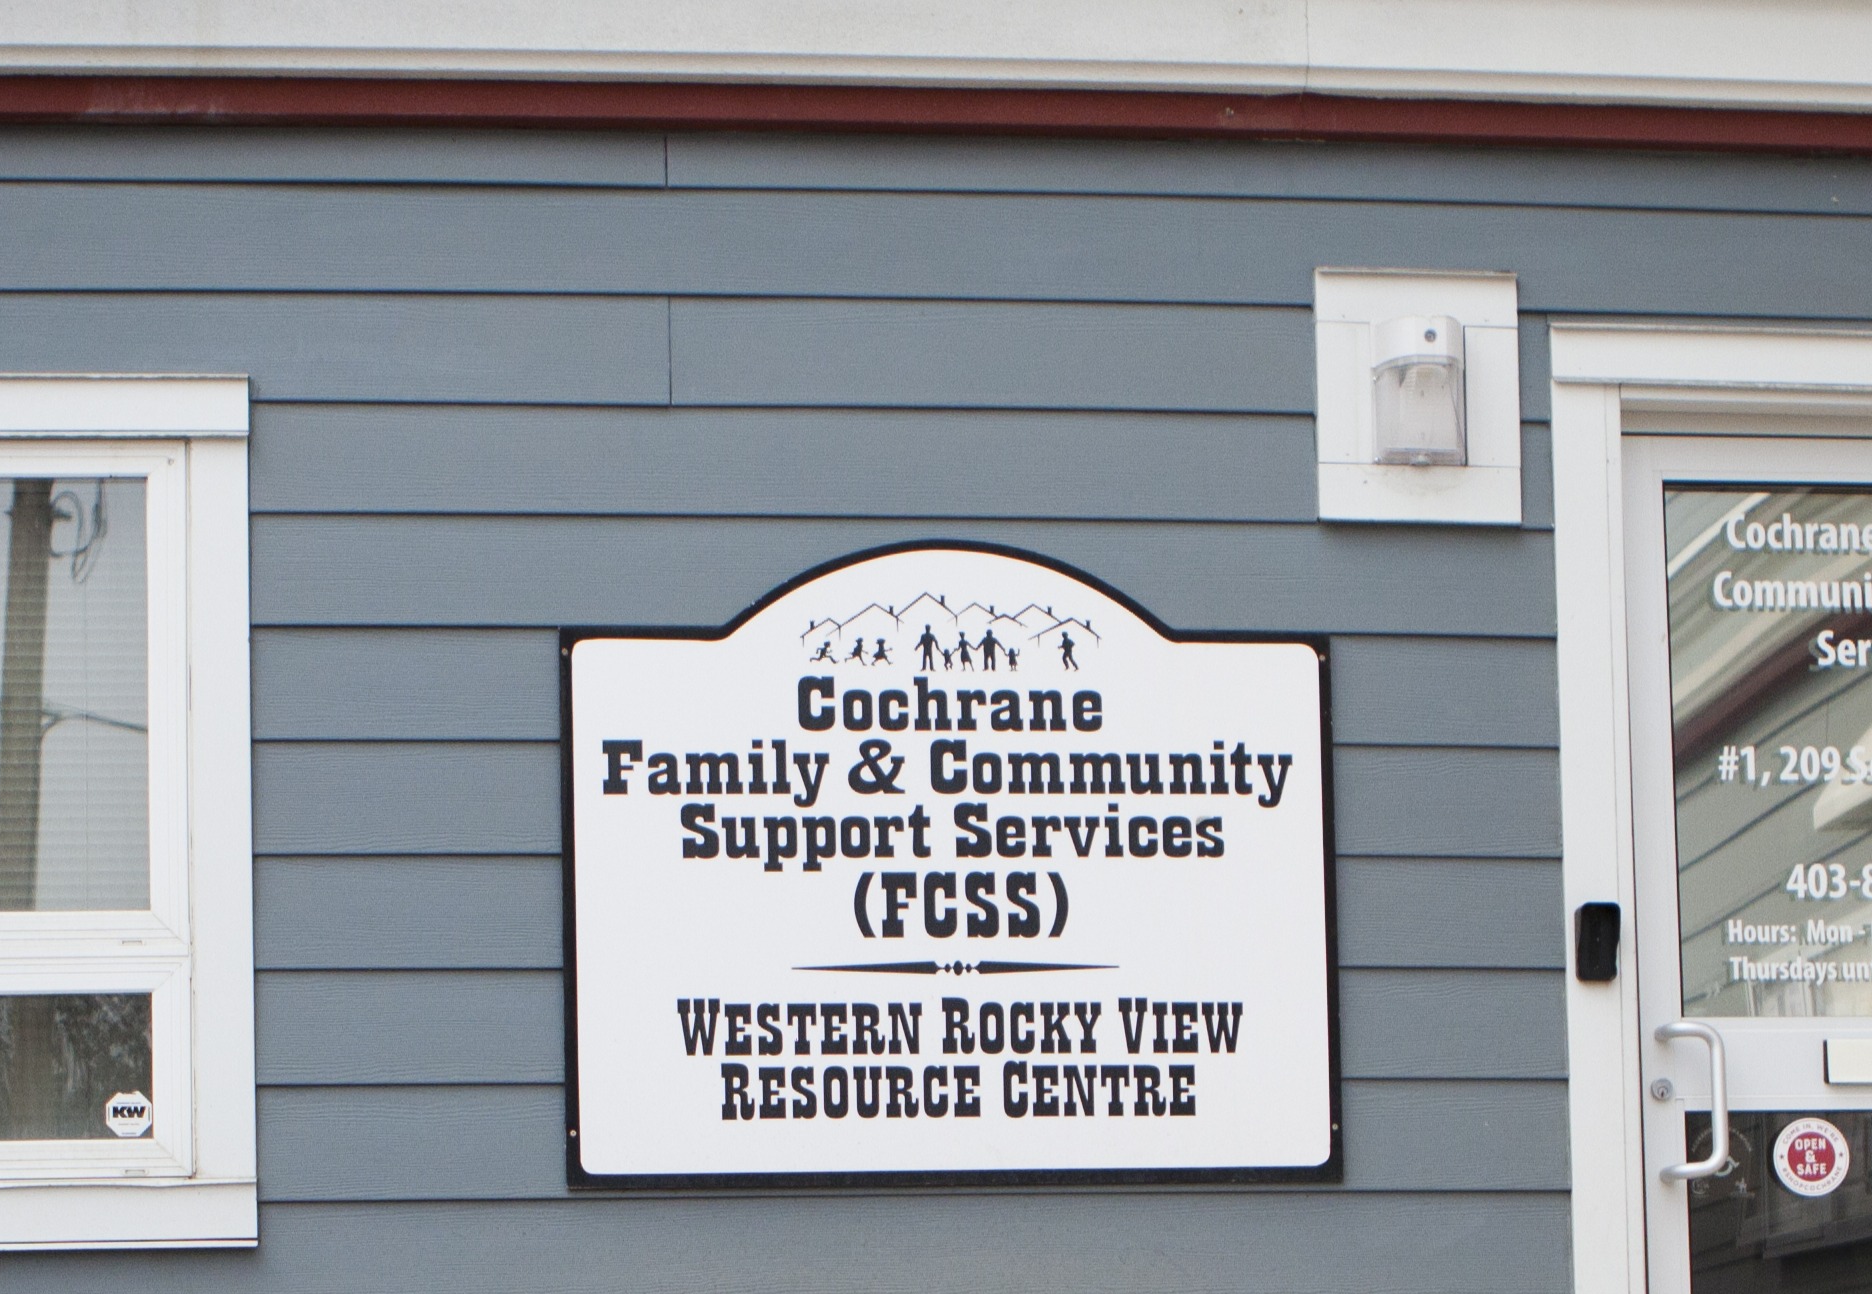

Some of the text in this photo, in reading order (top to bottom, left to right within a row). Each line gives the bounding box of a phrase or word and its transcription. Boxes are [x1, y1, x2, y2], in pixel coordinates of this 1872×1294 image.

[798, 676, 1103, 732] Cochrane
[603, 740, 1293, 807] Family & Community
[1718, 746, 1770, 788] #1,
[1780, 746, 1841, 783] 209
[681, 803, 1225, 871] Support Services
[853, 872, 1069, 939] (FCSS)
[1728, 919, 1797, 944] Hours:
[1806, 920, 1853, 944] Mon
[1730, 956, 1838, 987] Thursdays
[677, 998, 1243, 1056] WESTERN ROCKY VIEW
[113, 1106, 146, 1118] KW
[720, 1061, 1196, 1121] RESOURCE CENTRE
[1794, 1138, 1827, 1152] OPEN
[1805, 1149, 1816, 1163] &
[1796, 1163, 1827, 1176] SAFE
